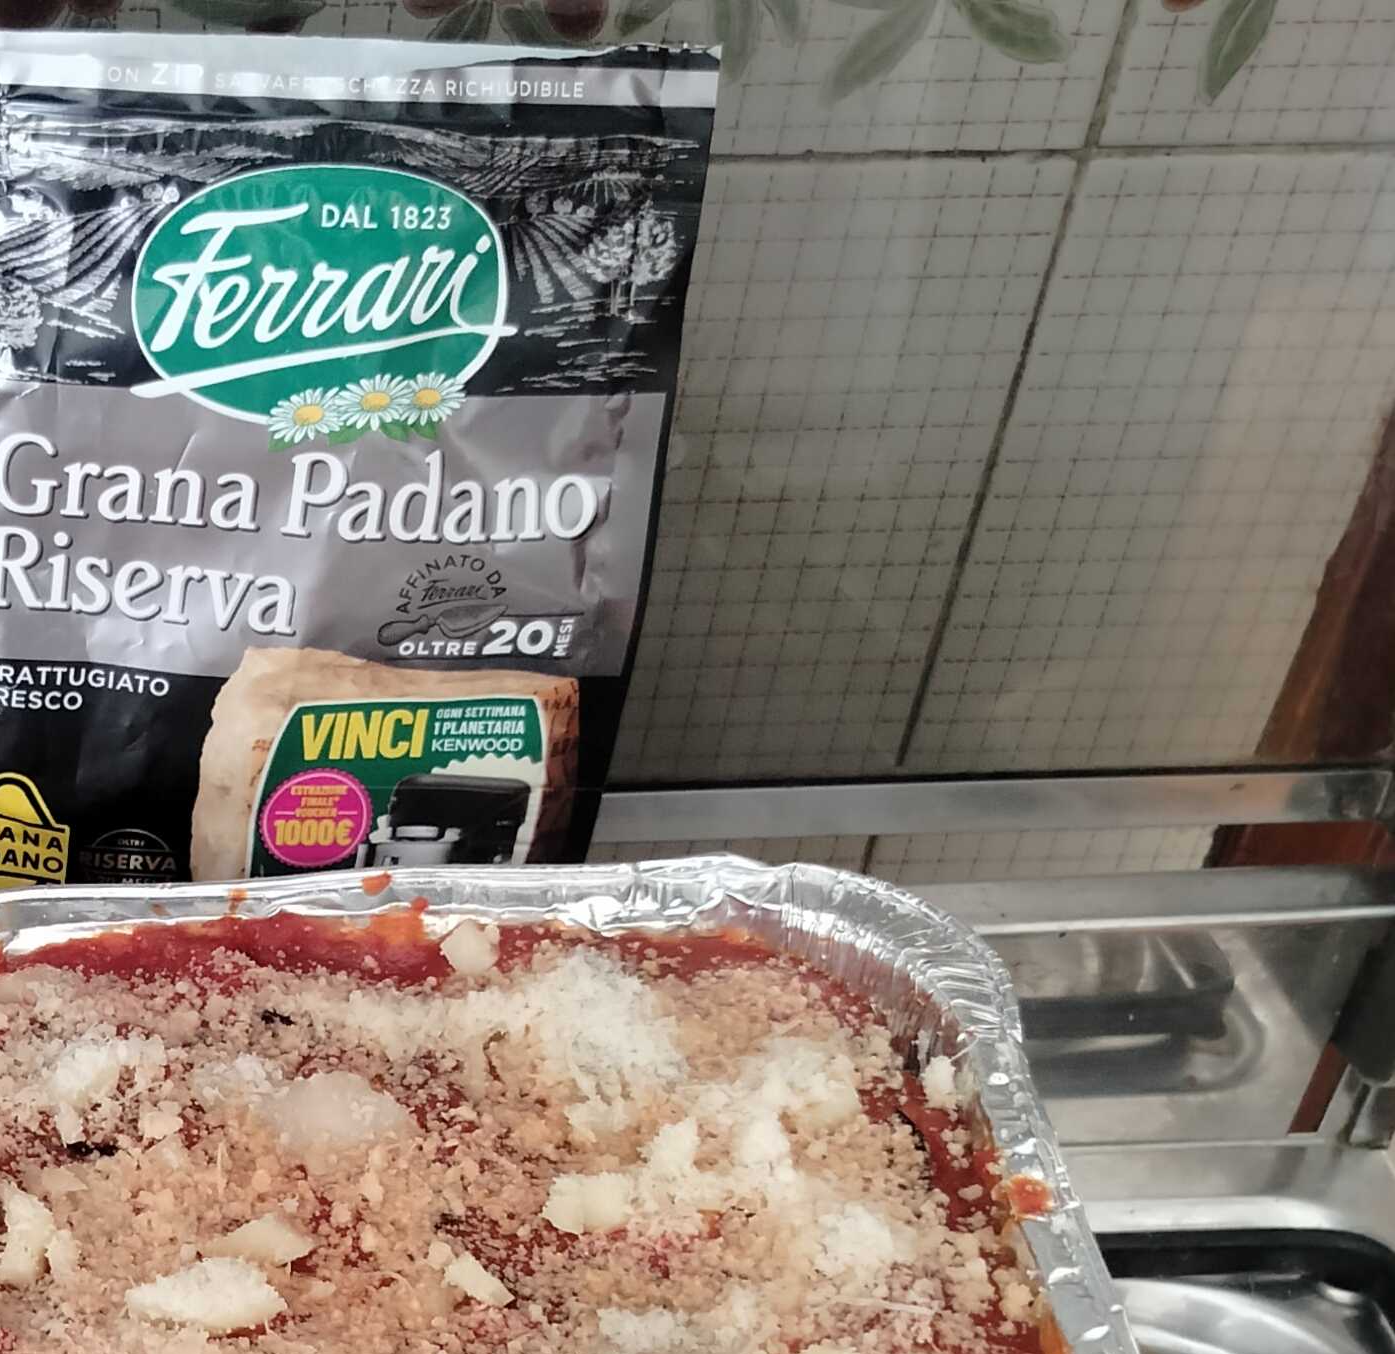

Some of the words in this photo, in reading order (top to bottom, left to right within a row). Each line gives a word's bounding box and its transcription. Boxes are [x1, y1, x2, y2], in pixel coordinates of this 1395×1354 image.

[106, 65, 140, 84] ON
[445, 79, 585, 98] RICHIUDIBILE
[320, 203, 378, 230] DAL
[390, 205, 452, 231] 1823
[151, 203, 494, 353] Ferrari
[280, 449, 599, 545] Padano
[396, 554, 485, 614] AFFINATO
[486, 570, 507, 599] DA
[398, 641, 478, 656] OLTRE
[481, 620, 554, 656] 20
[552, 618, 575, 657] MESI
[436, 708, 462, 719] OGNI
[463, 705, 526, 717] SETTIMANA
[442, 720, 525, 735] PLANETARIA
[301, 708, 429, 760] VINCI
[431, 738, 523, 752] KENWOOD
[274, 817, 355, 846] 1000€
[78, 851, 177, 871] RISERVA
